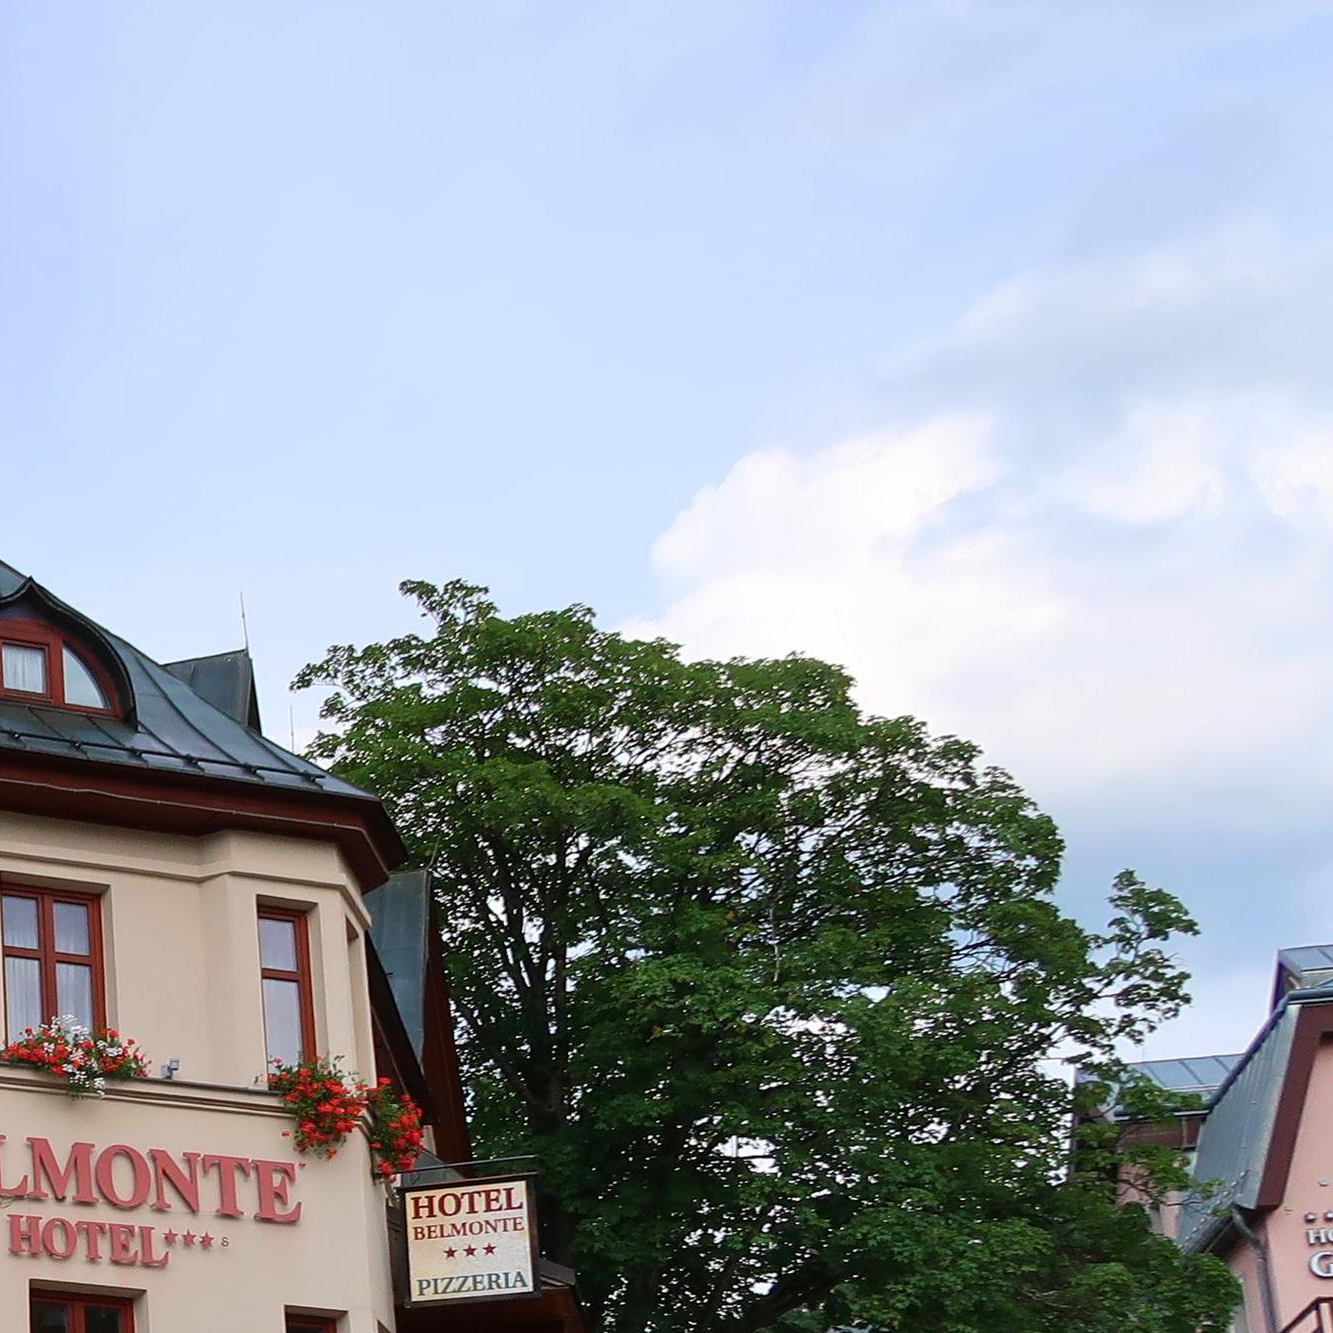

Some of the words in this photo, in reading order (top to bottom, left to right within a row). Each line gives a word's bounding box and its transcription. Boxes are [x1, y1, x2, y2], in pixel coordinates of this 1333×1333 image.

[410, 1187, 524, 1220] HOTEL
[6, 1213, 170, 1267] HOTEL
[412, 1216, 525, 1241] BELMONTE
[416, 1271, 528, 1297] PIZZERIA
